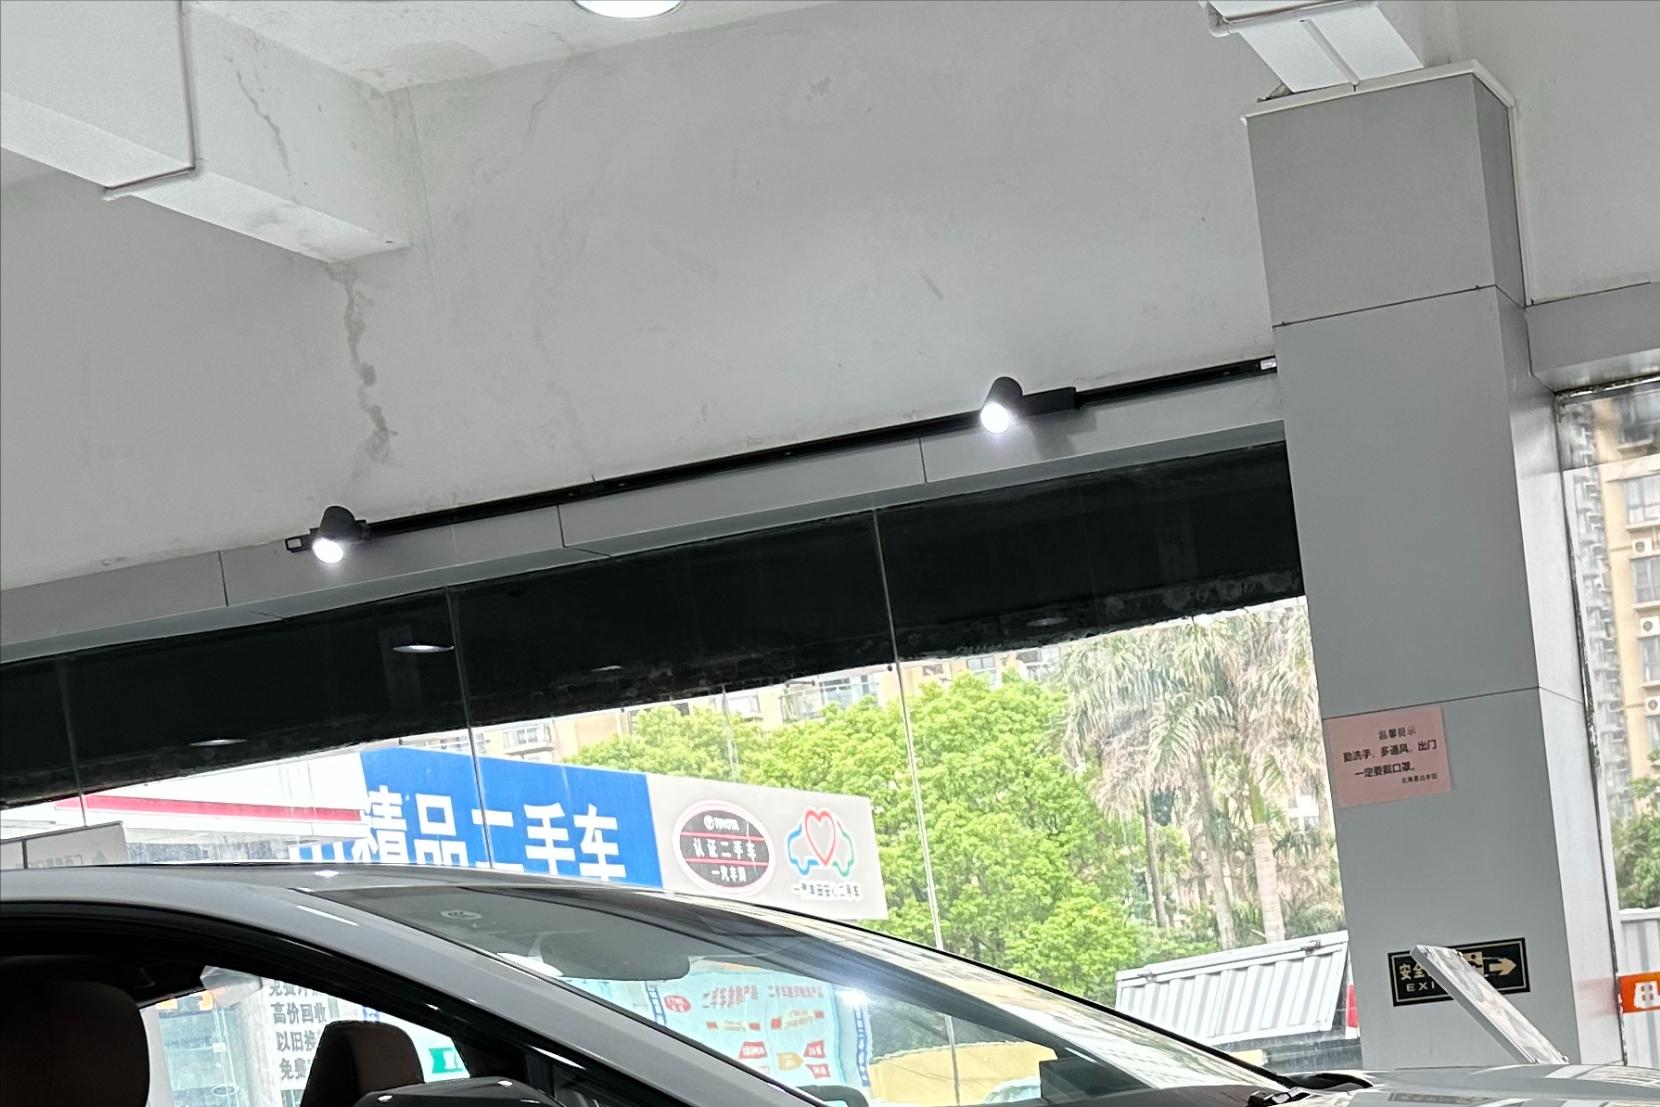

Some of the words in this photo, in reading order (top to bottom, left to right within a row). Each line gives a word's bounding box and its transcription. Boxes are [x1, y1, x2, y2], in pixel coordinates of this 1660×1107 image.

[1399, 962, 1428, 981] 安全
[1406, 981, 1436, 993] EXI
[270, 1001, 328, 1025] 高价回收
[275, 1029, 322, 1053] 以旧换
[279, 1057, 312, 1081] 免费
